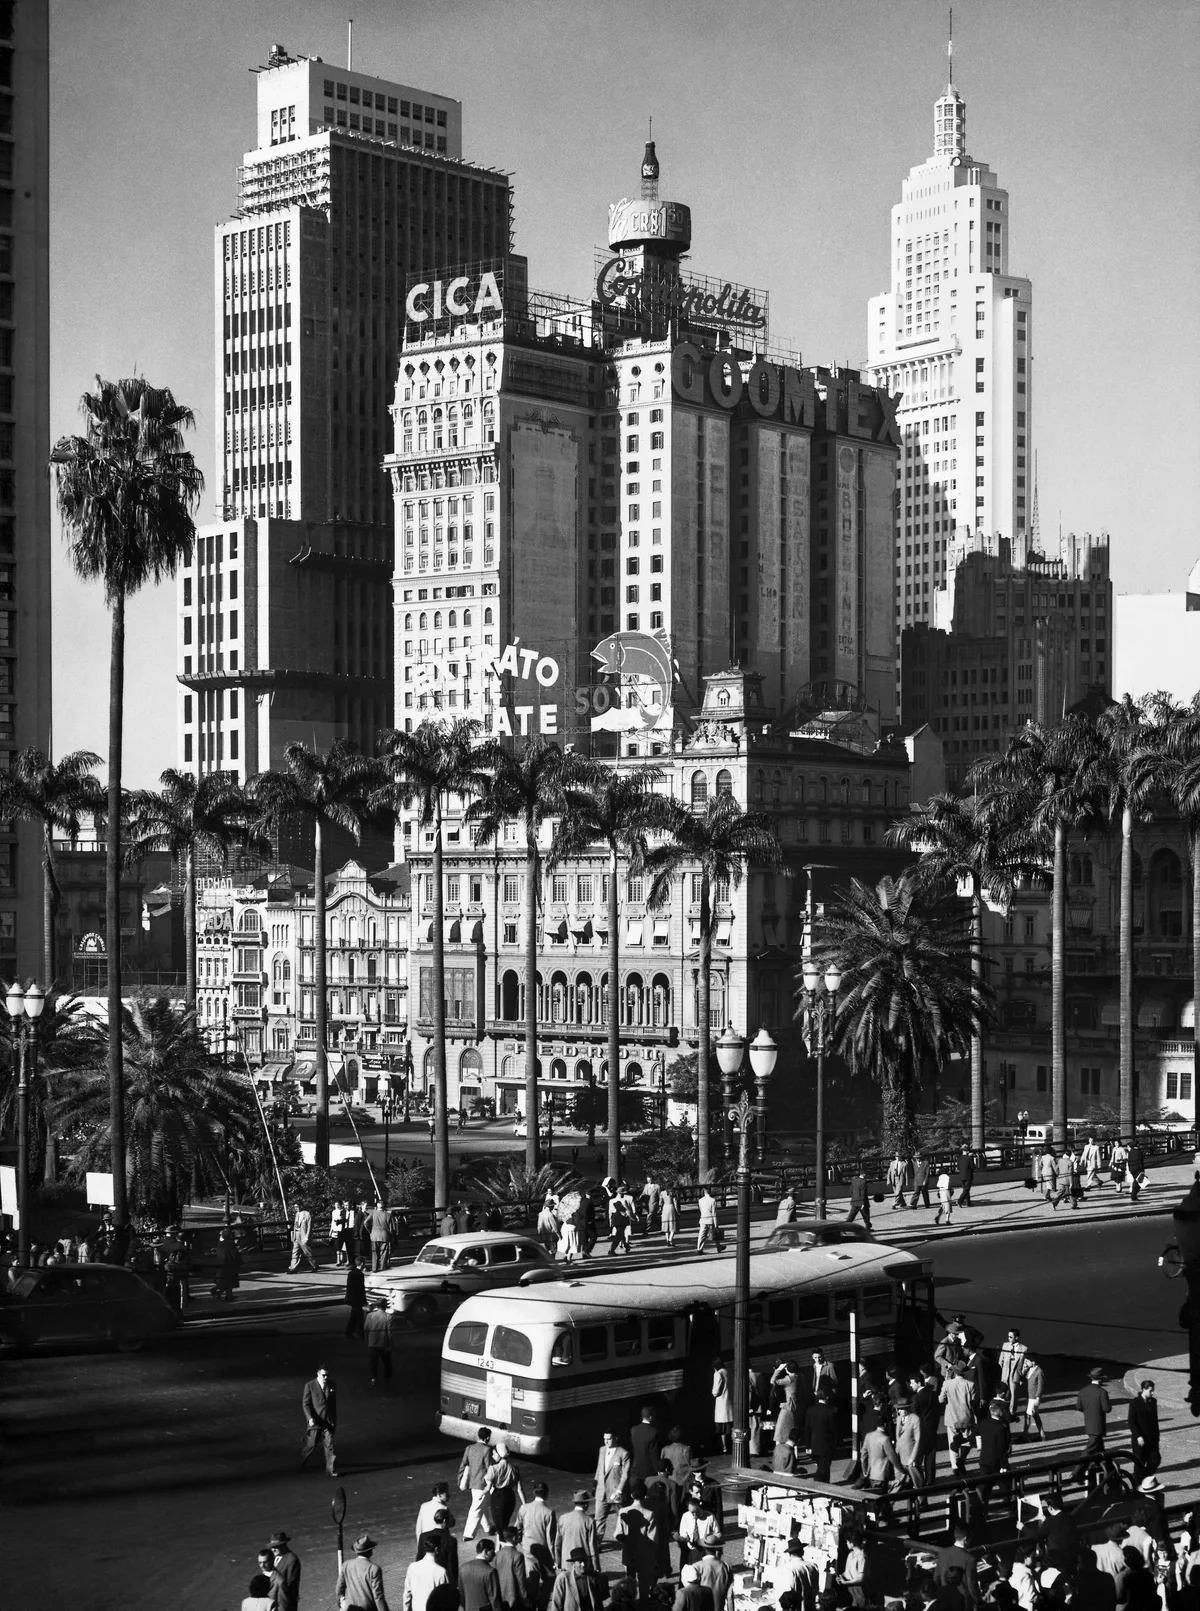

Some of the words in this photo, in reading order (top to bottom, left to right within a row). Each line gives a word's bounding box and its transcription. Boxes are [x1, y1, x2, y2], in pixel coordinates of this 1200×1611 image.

[405, 271, 503, 323] CICA
[671, 342, 904, 445] GOOMTEX
[197, 911, 234, 931] PEDA
[477, 1357, 495, 1370] 1243
